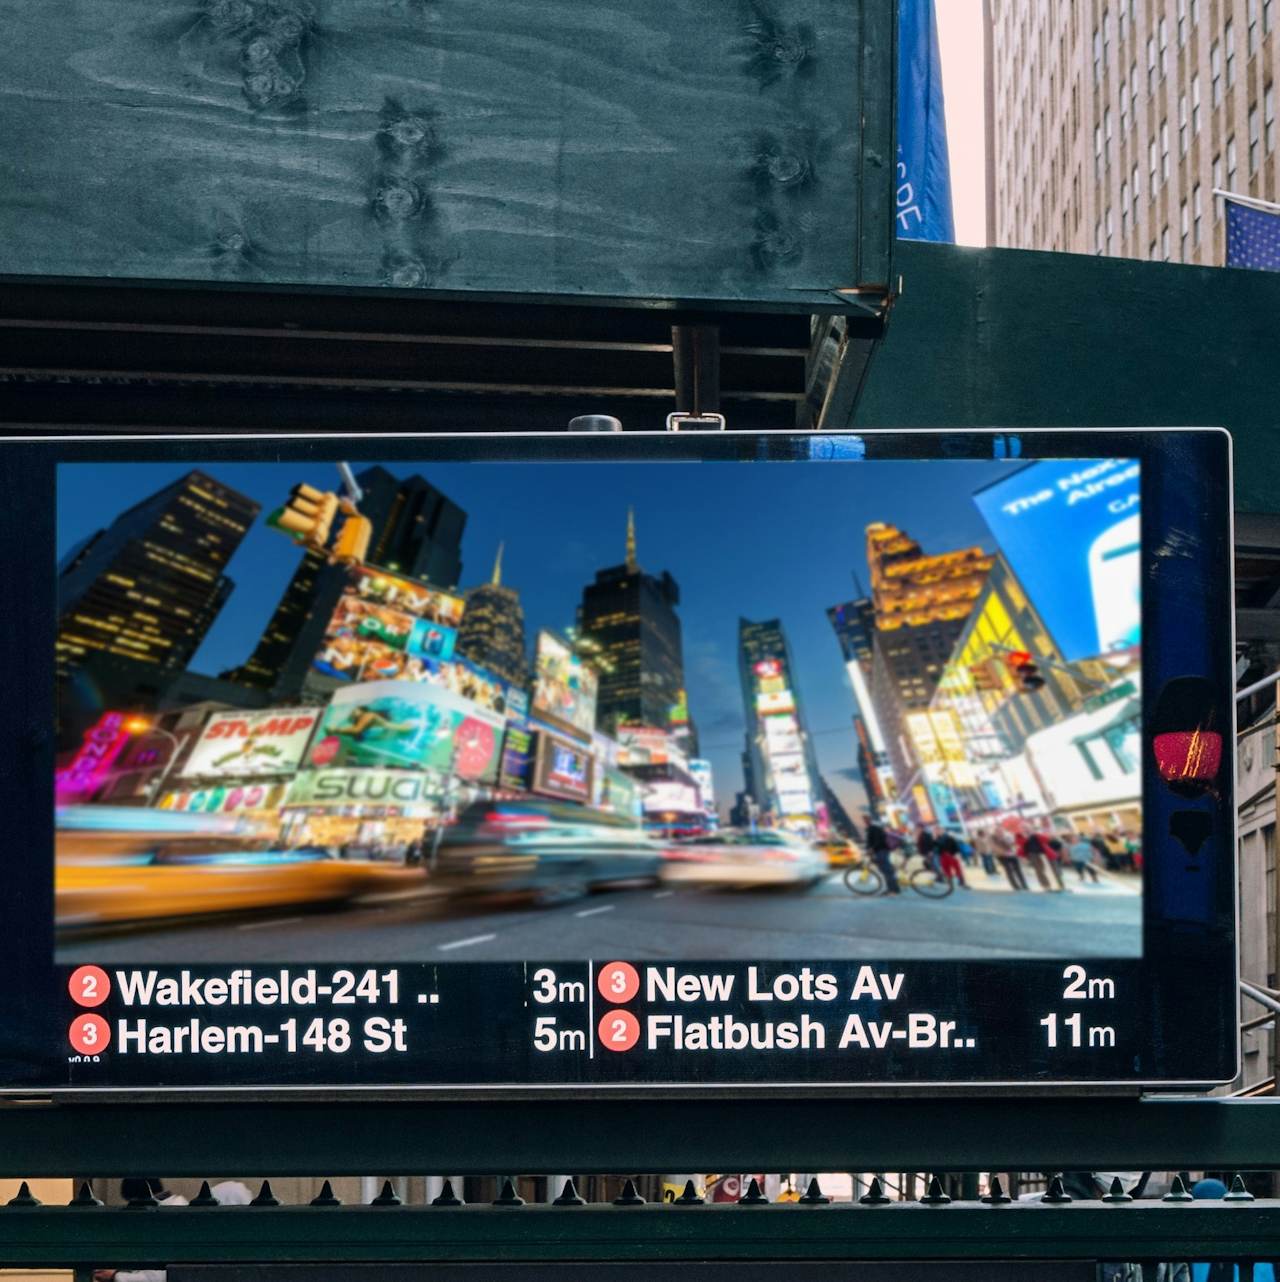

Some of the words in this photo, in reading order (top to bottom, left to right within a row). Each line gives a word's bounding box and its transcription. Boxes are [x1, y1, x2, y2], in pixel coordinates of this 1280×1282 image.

[116, 969, 398, 1005] Wakefield-241
[533, 969, 585, 1004] 3m
[646, 967, 735, 1001] New
[748, 967, 838, 1002] Lots
[850, 966, 905, 1001] Av
[1062, 965, 1115, 999] 2m
[118, 1017, 351, 1053] Harlem-148
[363, 1017, 408, 1053] St
[533, 1017, 585, 1052] 5m
[647, 1014, 826, 1050] Flatbush
[839, 1013, 976, 1049] Av-Br..
[1040, 1013, 1115, 1048] 11m
